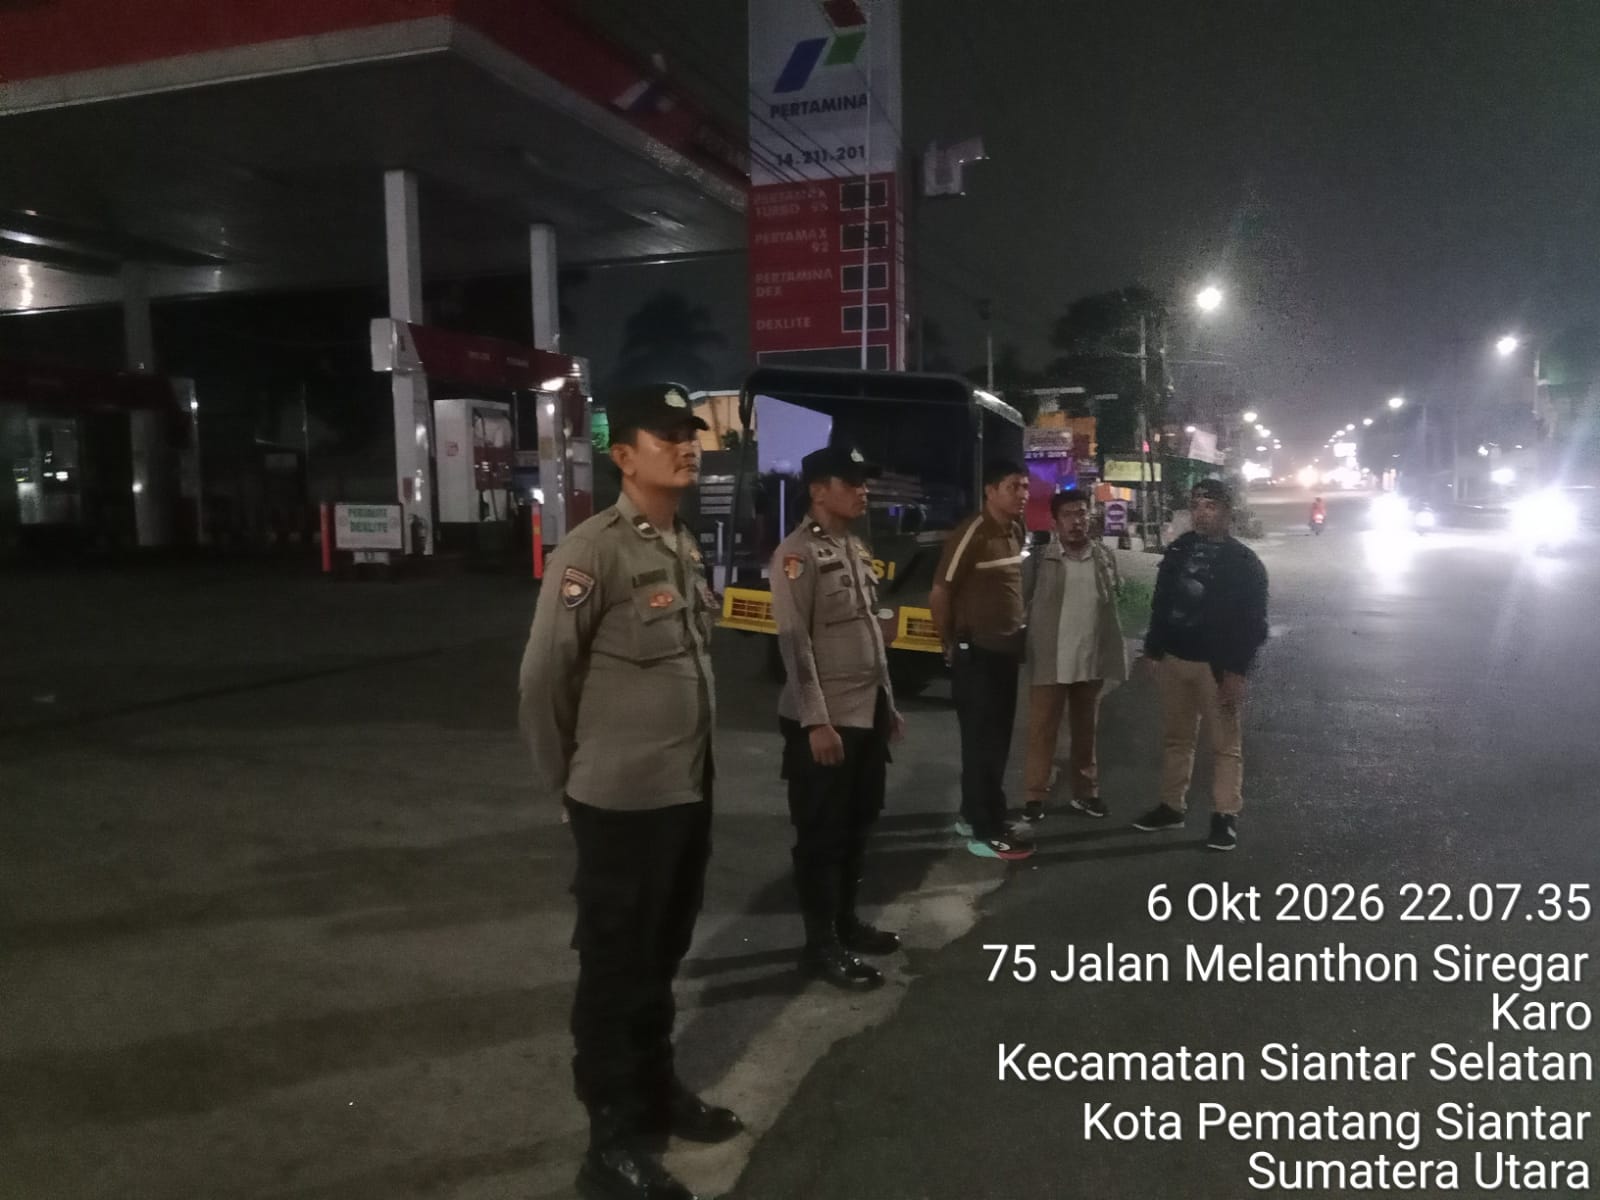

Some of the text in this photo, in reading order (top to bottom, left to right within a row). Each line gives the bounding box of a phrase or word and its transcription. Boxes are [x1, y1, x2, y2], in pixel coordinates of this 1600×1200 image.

[769, 93, 868, 119] PERTAMINA
[754, 227, 828, 245] PERTAMAX
[754, 268, 833, 284] PERTAMINA
[755, 286, 783, 298] DEX
[755, 316, 812, 331] DEXLITE
[871, 558, 897, 581] SI
